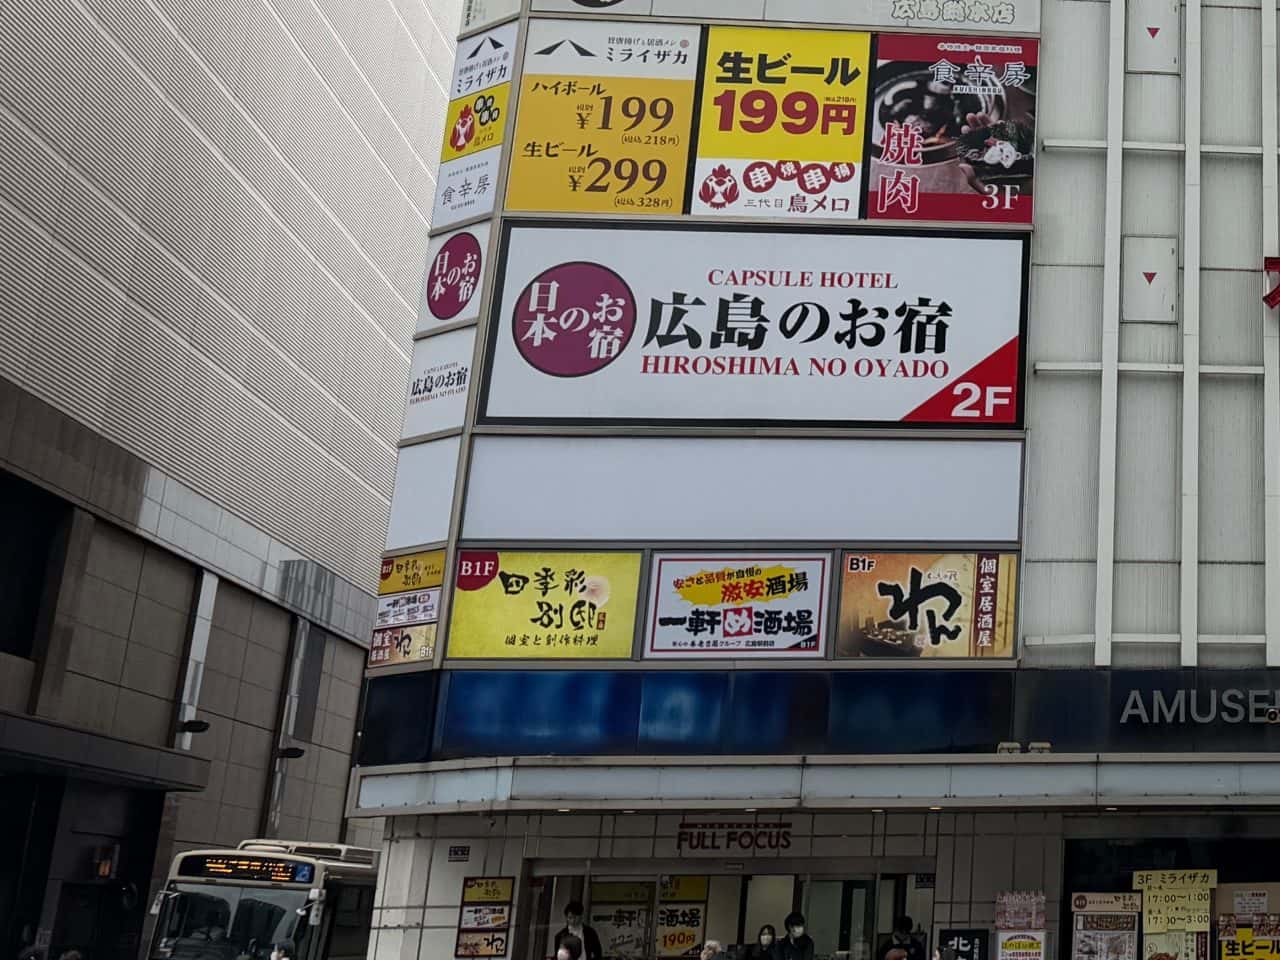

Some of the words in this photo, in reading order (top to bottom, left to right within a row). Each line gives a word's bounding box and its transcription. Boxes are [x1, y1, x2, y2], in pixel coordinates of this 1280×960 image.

[605, 47, 688, 65] ミライザカ
[715, 51, 861, 87] 生ビール
[456, 64, 508, 93] ミライザカ
[531, 80, 607, 97] ハイボール
[576, 96, 675, 133] ¥199
[713, 89, 857, 136] 199円
[522, 141, 599, 158] 生ビール
[568, 157, 668, 195] ¥299
[876, 122, 924, 214] 焼肉
[743, 198, 784, 209] 三代目
[787, 193, 850, 214] 鳥メロ
[981, 183, 1020, 210] 3F
[707, 269, 813, 289] CAPSULE
[819, 271, 899, 290] HOTEL
[641, 292, 953, 355] 広島のお宿
[640, 354, 800, 377] HIROSHIMA
[809, 356, 848, 378] NO
[853, 357, 950, 379] OYADO
[410, 366, 469, 397] 広島のお宿
[951, 381, 1013, 418] 2F
[460, 560, 495, 577] B1F
[848, 557, 875, 571] B1F
[720, 571, 809, 604] 激安酒場
[876, 566, 962, 646] わん
[977, 558, 997, 648] 個室居酒屋
[658, 607, 814, 638] 一軒め酒場
[677, 831, 721, 850] FULL
[726, 831, 792, 850] FOCUS
[1137, 873, 1153, 885] 3F
[1159, 872, 1210, 884] ミライザカ
[658, 908, 702, 929] 酒場
